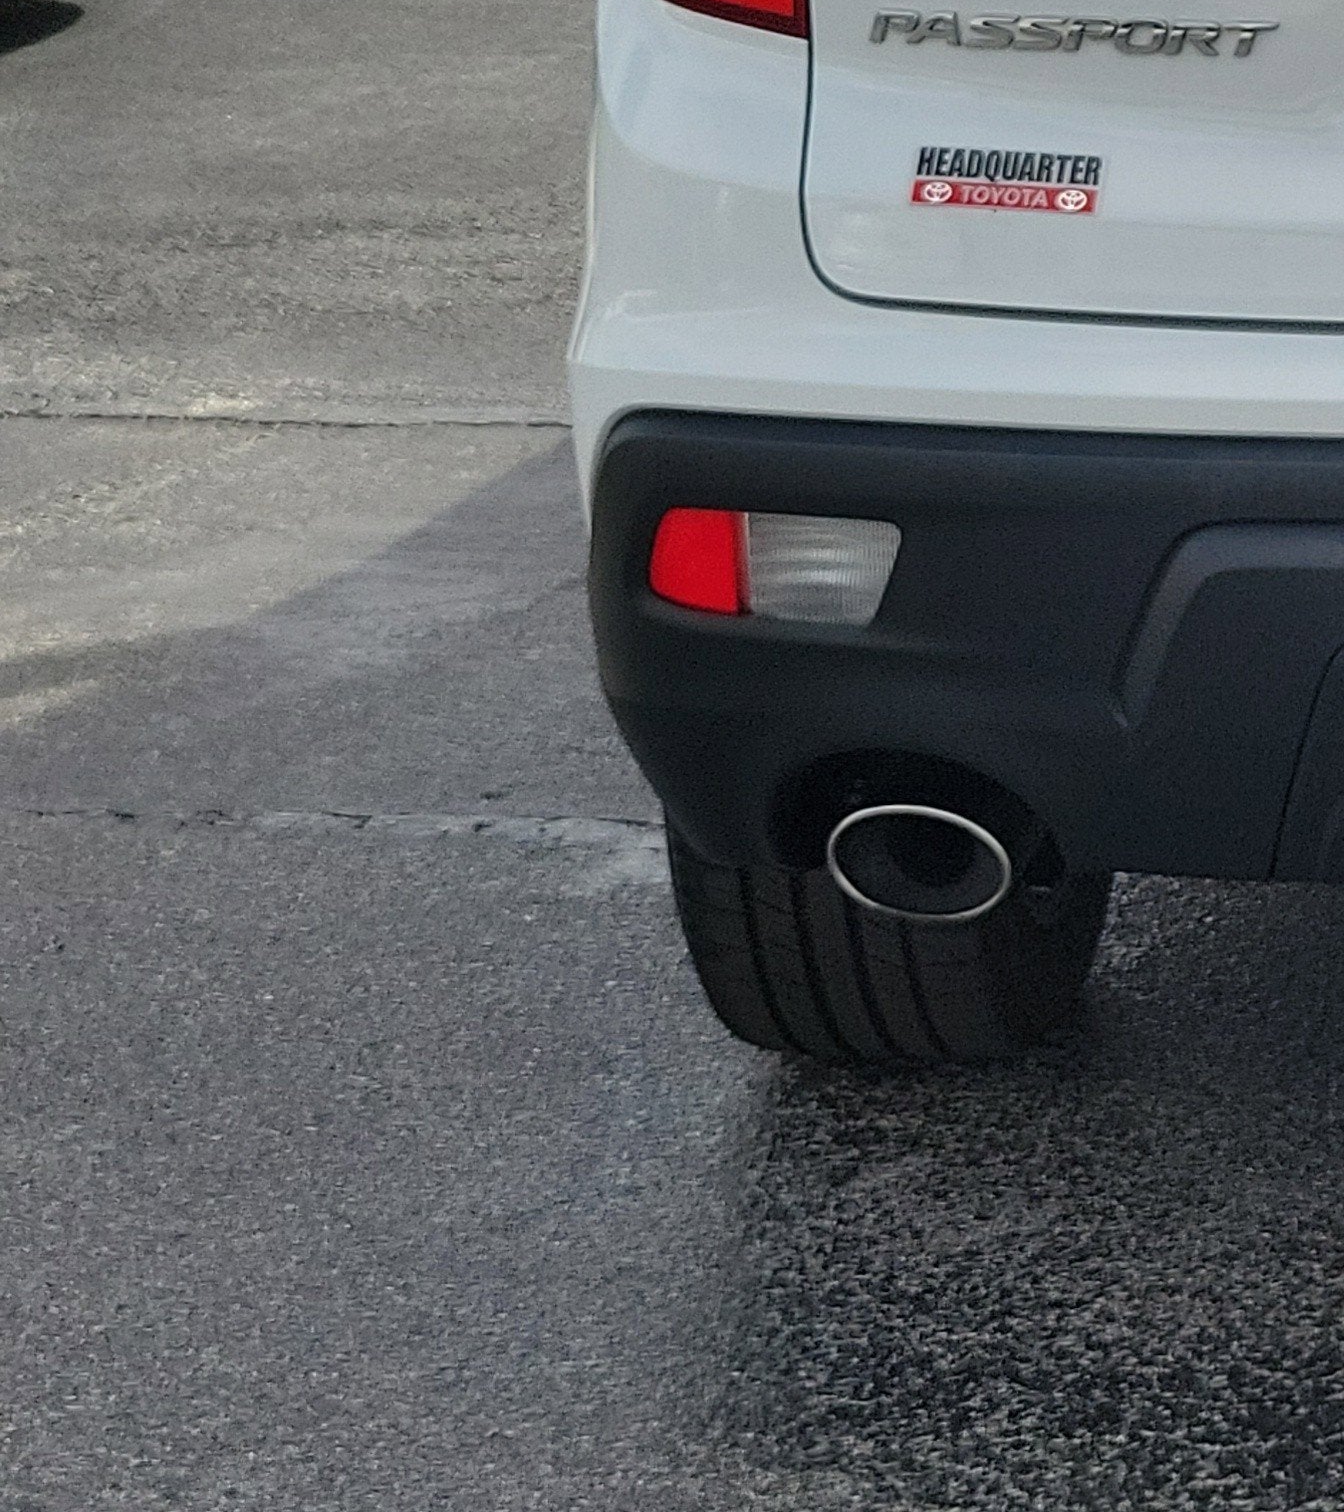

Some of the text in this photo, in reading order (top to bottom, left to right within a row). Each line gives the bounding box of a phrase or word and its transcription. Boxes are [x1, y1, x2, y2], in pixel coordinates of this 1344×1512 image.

[868, 6, 1281, 58] PASSPORT
[916, 146, 1102, 186] HEADQUARTER
[960, 187, 1049, 209] TOYOTA
